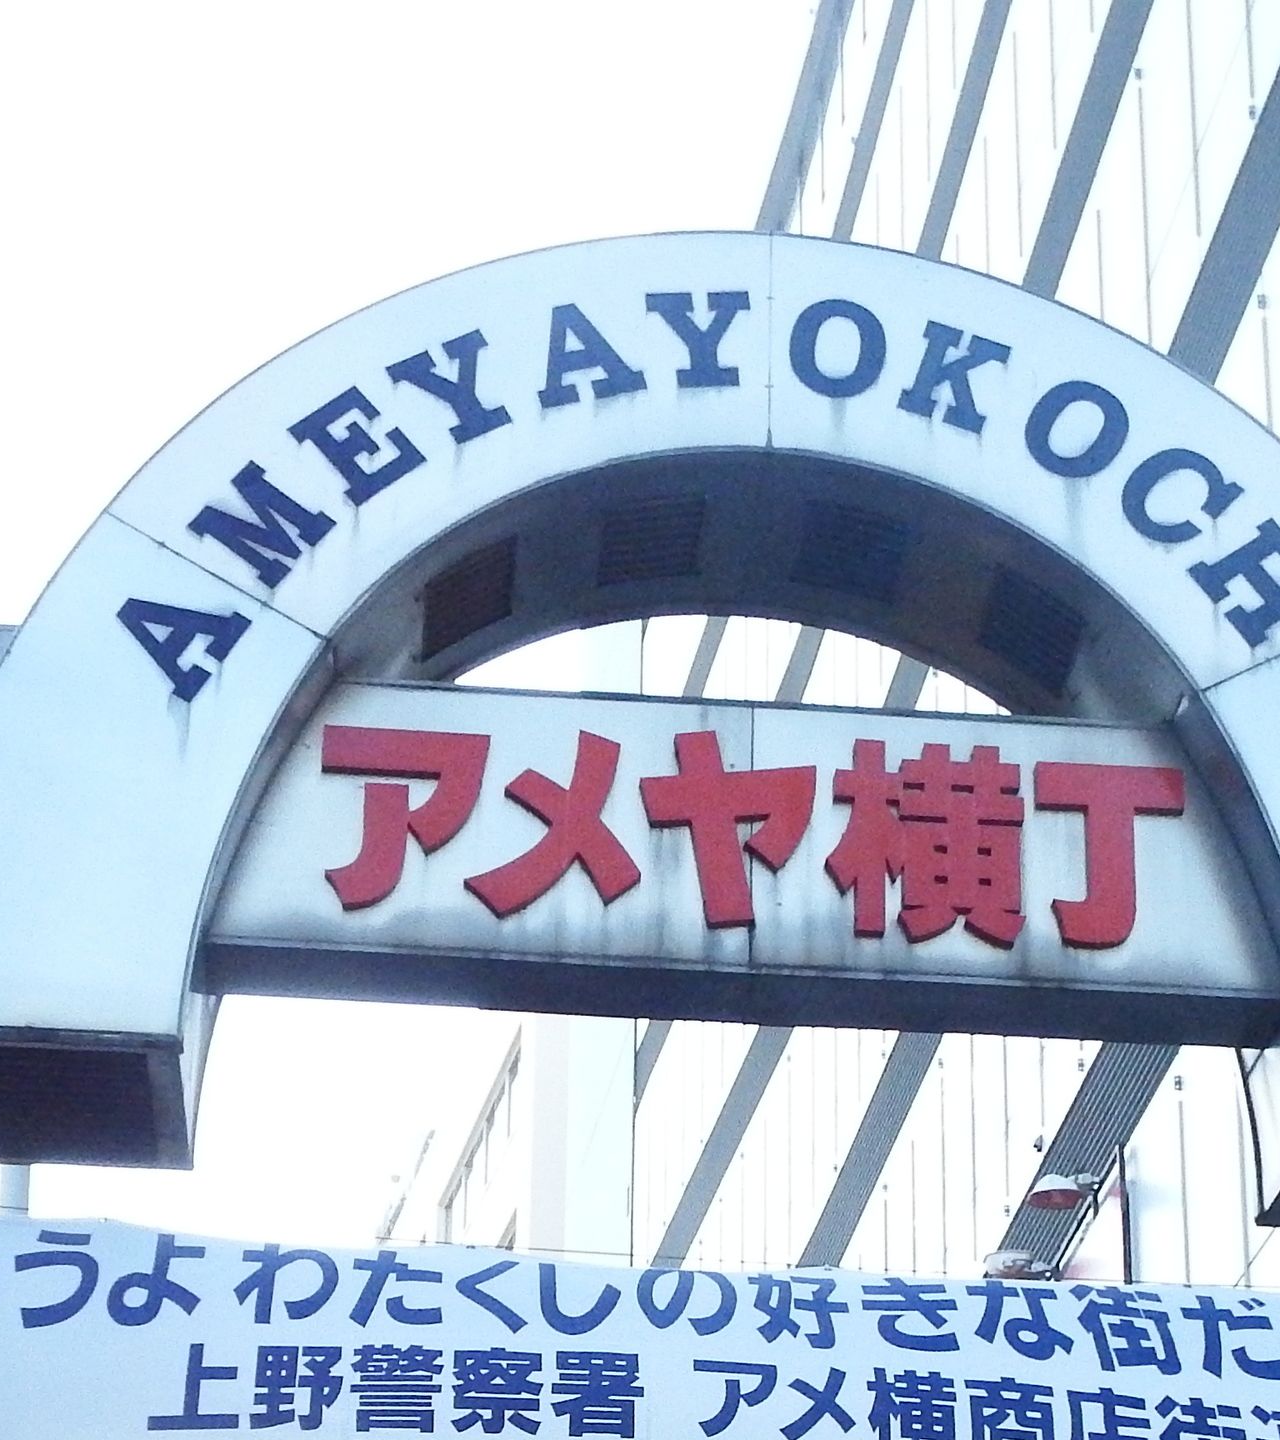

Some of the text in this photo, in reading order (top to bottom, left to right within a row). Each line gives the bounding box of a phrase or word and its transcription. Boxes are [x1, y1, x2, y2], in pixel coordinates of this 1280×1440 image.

[320, 722, 1188, 948] アメヤ横丁
